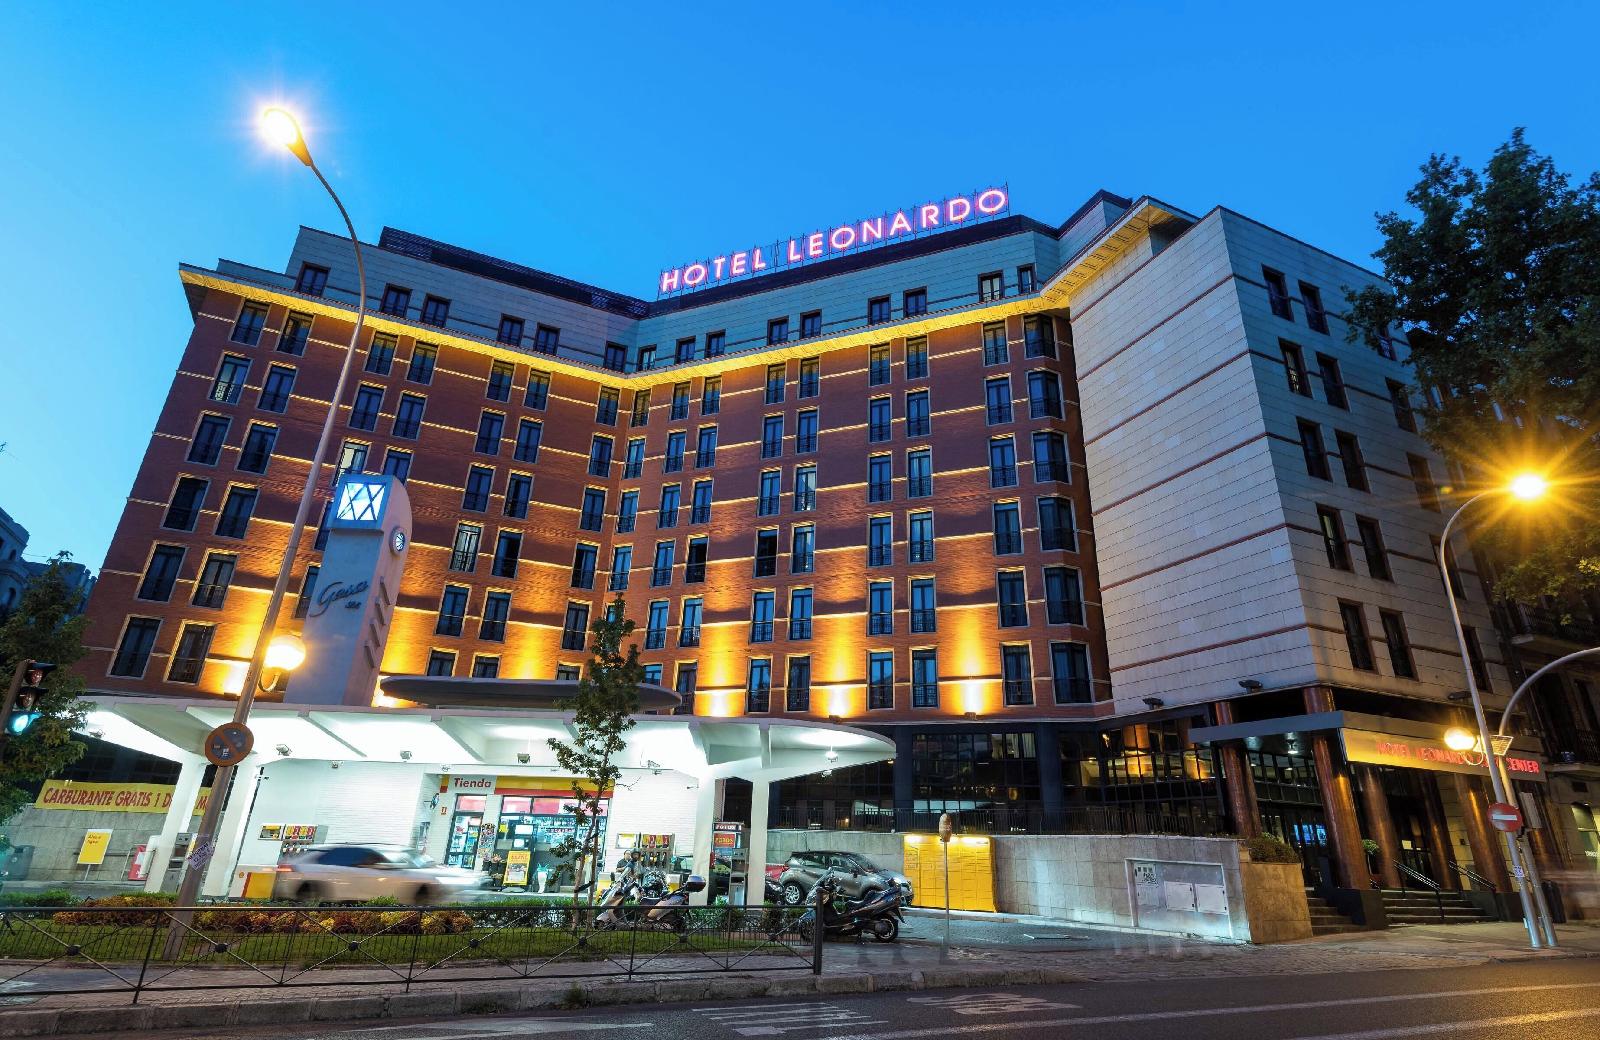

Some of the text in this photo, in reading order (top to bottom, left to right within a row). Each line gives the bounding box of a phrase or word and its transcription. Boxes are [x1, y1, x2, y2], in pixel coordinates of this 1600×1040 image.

[662, 189, 1007, 293] HOTEL LEONARDO
[1376, 742, 1411, 760] HOTEL
[1415, 747, 1474, 765] LEONARDO
[1506, 757, 1540, 774] CENTER
[453, 777, 492, 788] Tienda
[43, 788, 115, 806] CARBURANTE
[115, 789, 153, 807] GRATIS
